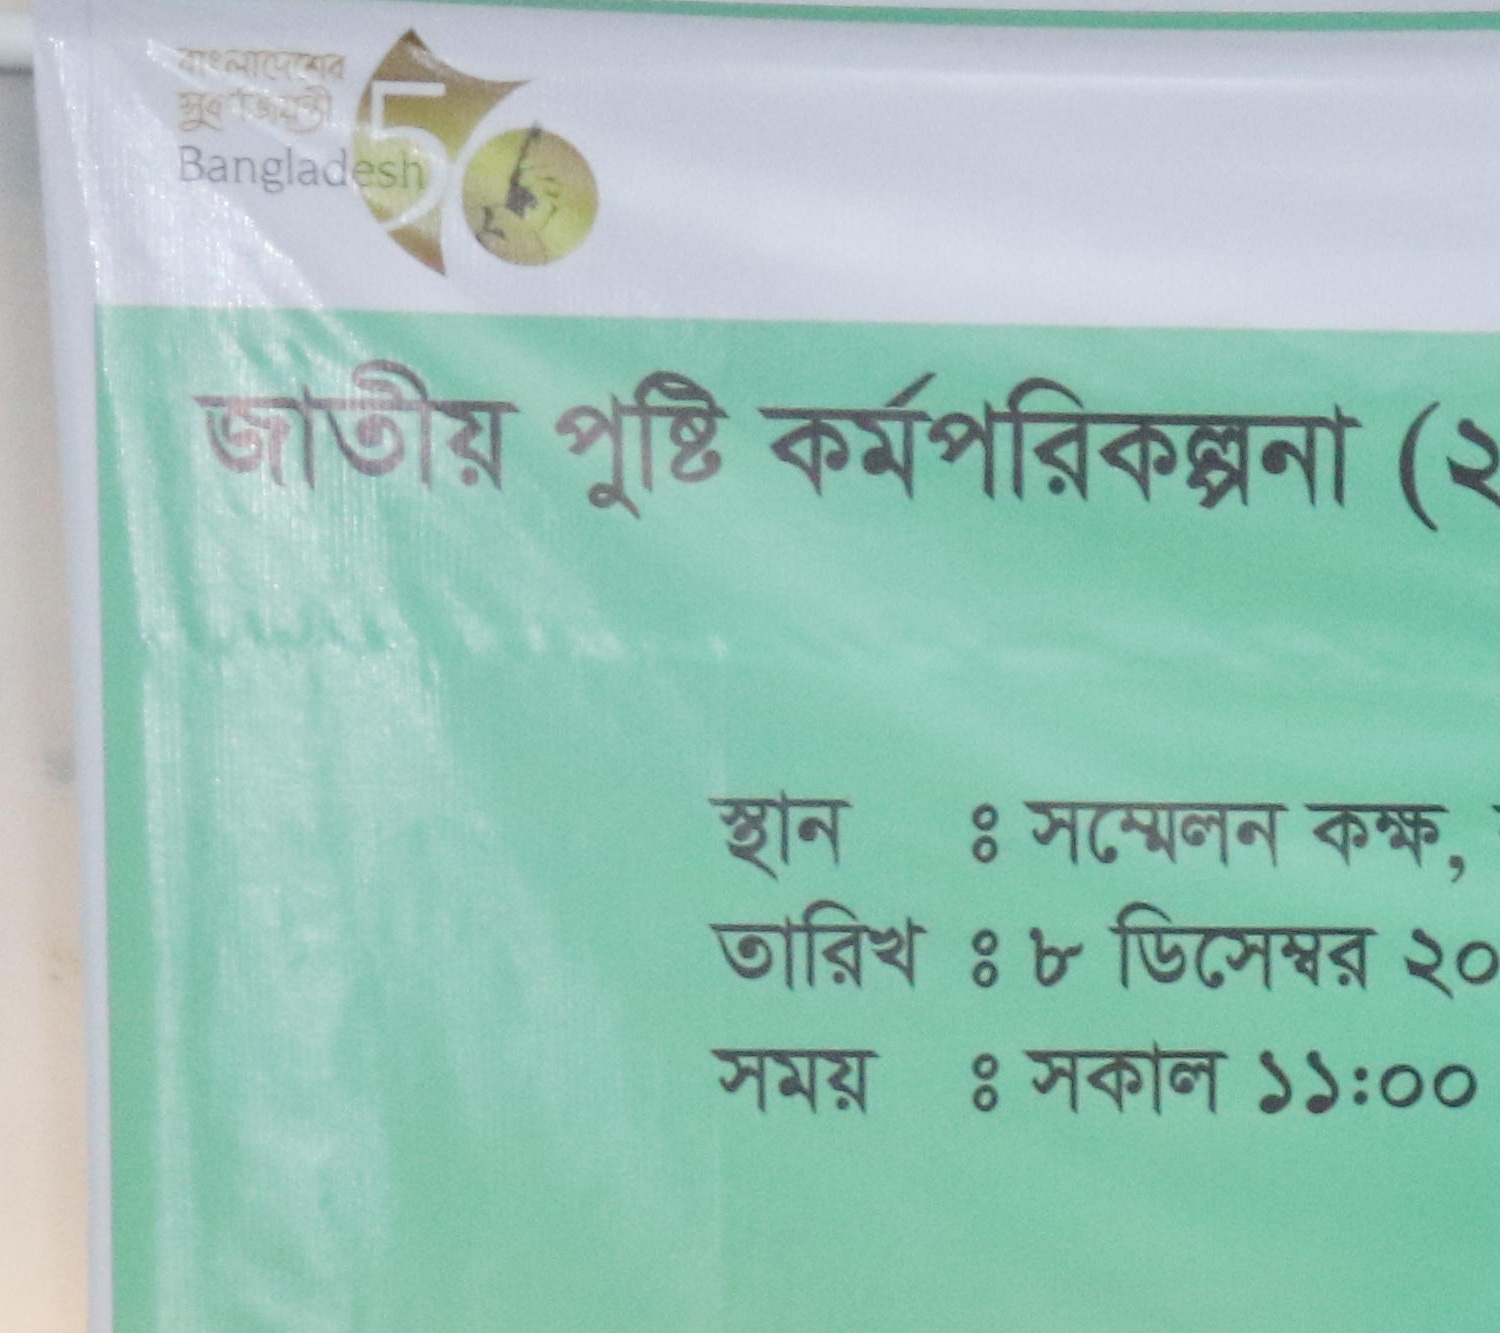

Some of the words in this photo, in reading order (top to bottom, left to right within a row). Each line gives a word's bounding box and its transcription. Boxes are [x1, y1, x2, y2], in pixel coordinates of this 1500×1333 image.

[180, 145, 424, 193] Bangladesh
[195, 360, 519, 492] জাতীয়
[557, 371, 729, 517] পুষ্টি
[759, 373, 1362, 509] কর্মপরিকল্পনা
[708, 791, 852, 878] স্থান
[1024, 800, 1289, 866] সম্মেলন
[1305, 803, 1465, 882] কক্ষ,
[709, 899, 927, 989] তারিখ
[1030, 927, 1082, 987] ৮
[1109, 901, 1377, 989] ডিসেম্বর
[711, 1048, 880, 1113] সময়
[1025, 1042, 1228, 1114] সকাল
